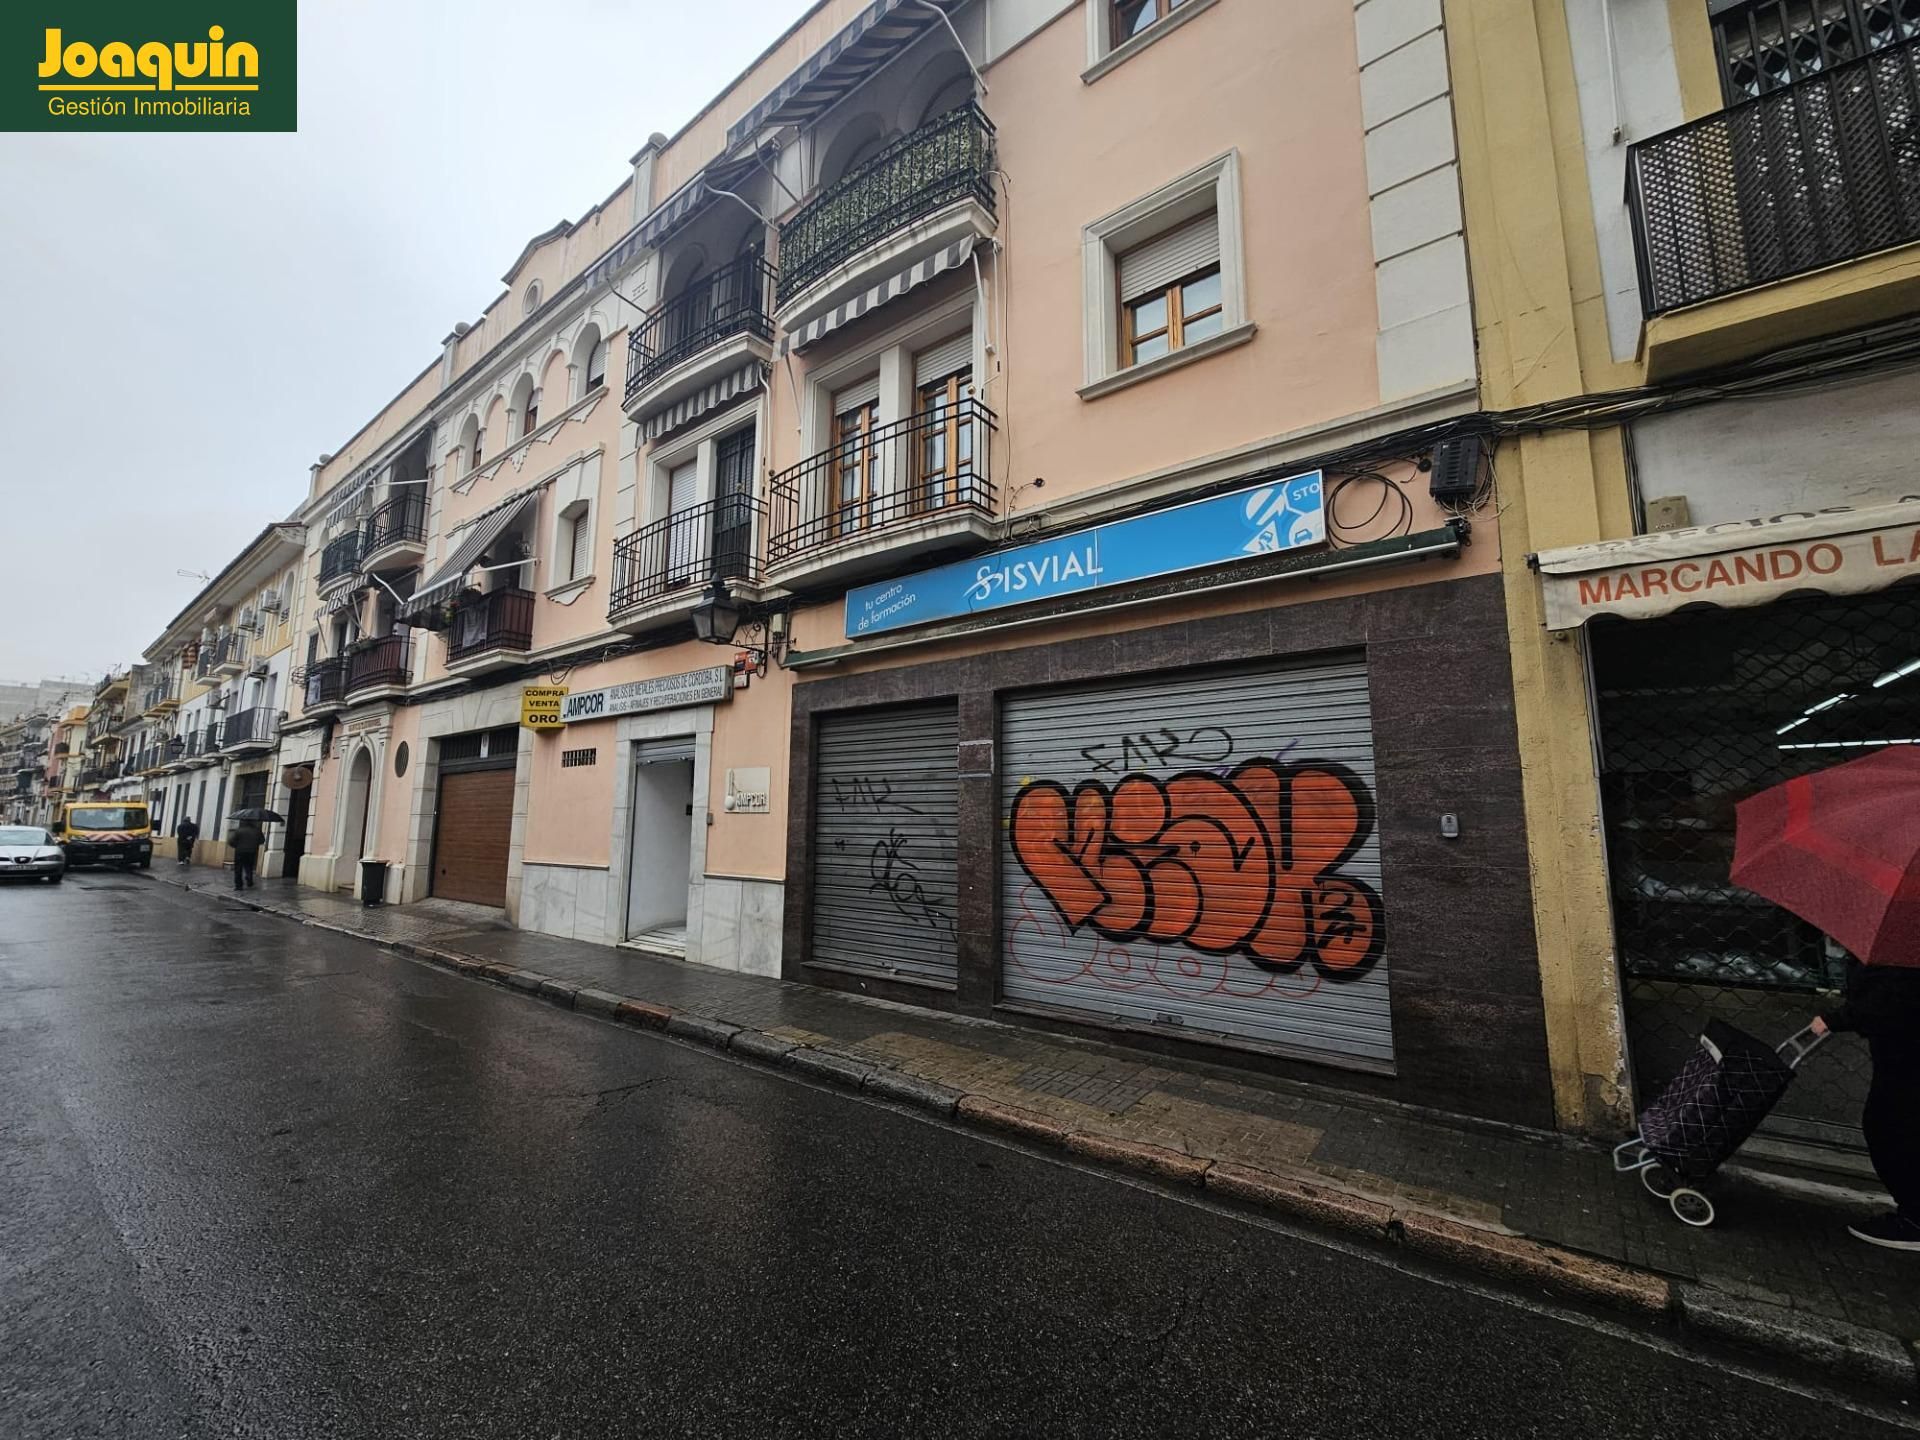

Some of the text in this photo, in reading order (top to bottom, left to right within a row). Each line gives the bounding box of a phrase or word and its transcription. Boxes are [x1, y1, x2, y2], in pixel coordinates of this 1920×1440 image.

[967, 544, 1104, 600] SISVIAL
[1578, 543, 1843, 606] MARCANDO
[857, 593, 916, 631] de formación
[865, 584, 903, 611] tu centro
[529, 714, 558, 723] ORO
[567, 693, 604, 717] AMPCOR
